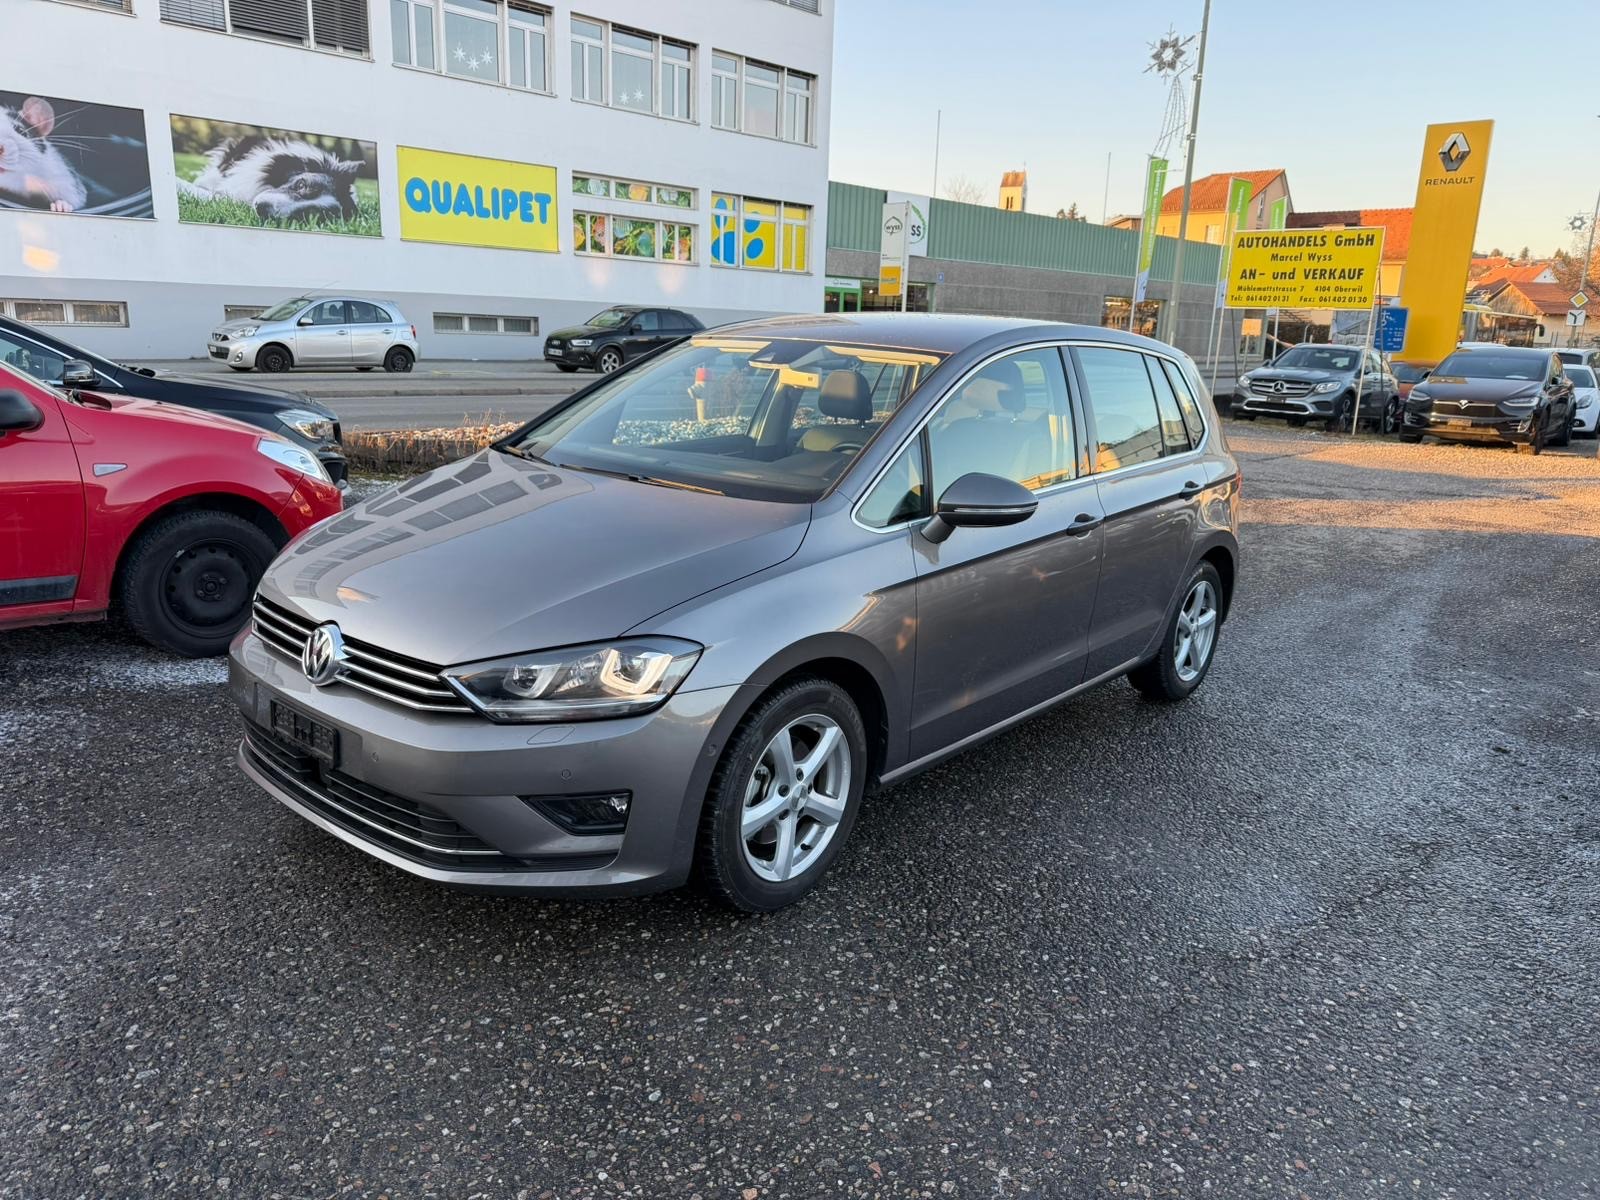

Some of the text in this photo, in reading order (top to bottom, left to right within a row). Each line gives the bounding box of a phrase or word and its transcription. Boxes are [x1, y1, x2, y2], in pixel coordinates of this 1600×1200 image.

[1425, 176, 1476, 186] RENAULT
[404, 176, 552, 225] QUALIPET
[1237, 234, 1375, 248] AUTOHANDELS GmbH
[1270, 253, 1333, 263] Marcel Wyss
[1272, 268, 1296, 280] und
[1303, 268, 1365, 280] VERKAUF
[1334, 285, 1363, 293] Oberwil
